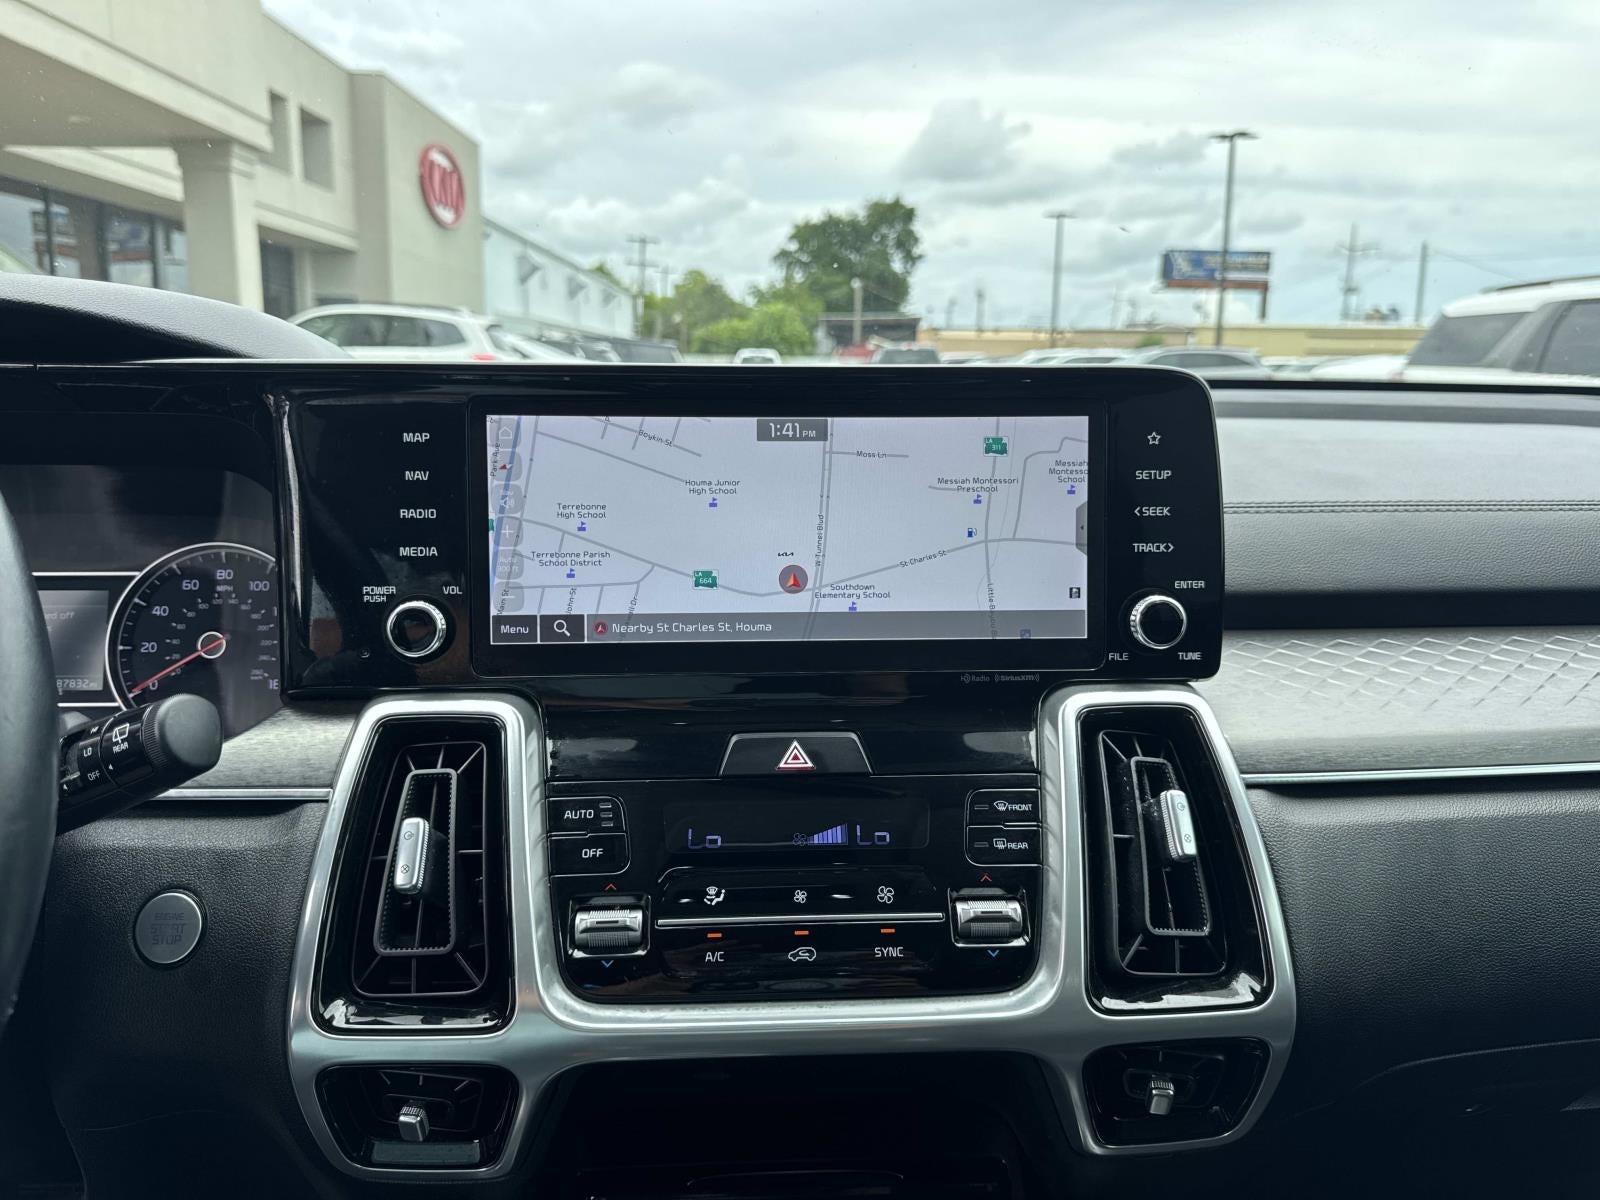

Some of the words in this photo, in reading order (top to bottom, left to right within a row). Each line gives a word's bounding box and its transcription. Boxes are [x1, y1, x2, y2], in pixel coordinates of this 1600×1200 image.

[769, 422, 800, 438] 1:41
[802, 430, 816, 438] PM
[402, 432, 430, 443] MAP
[856, 450, 876, 458] Moss
[877, 451, 887, 459] Ln
[404, 470, 430, 481] NAV
[937, 477, 970, 485] Messiah
[972, 476, 1019, 485] Montessori
[1057, 475, 1086, 484] School
[1135, 470, 1172, 480] SETUP
[685, 479, 711, 487] Houma
[713, 479, 741, 487] Junior
[956, 484, 999, 493] Preschool
[688, 487, 707, 496] High
[708, 486, 737, 495] School
[556, 502, 607, 511] Terrebonne
[399, 508, 437, 519] RADIO
[556, 510, 575, 519] High
[577, 510, 607, 519] School
[399, 546, 438, 557] MEDIA
[531, 551, 581, 559] Terrebonne
[583, 551, 611, 559] Parish
[538, 559, 568, 567] School
[570, 559, 603, 567] District
[899, 560, 909, 568] St
[909, 552, 938, 565] Charles
[938, 549, 947, 557] St
[216, 569, 234, 580] 80
[182, 579, 200, 591] 60
[249, 580, 270, 592] 100
[362, 585, 396, 595] POWER
[442, 585, 463, 595] VOL
[830, 583, 875, 591] Southdown
[1174, 580, 1205, 589] ENTER
[363, 595, 387, 603] PUSH
[814, 591, 861, 600] Elementary
[863, 591, 891, 599] School
[151, 605, 169, 617] 40
[500, 624, 529, 635] Menu
[612, 623, 654, 635] Nearby
[656, 622, 670, 633] St
[672, 621, 715, 633] Charles
[717, 621, 733, 634] St,
[735, 621, 772, 632] Houma
[140, 641, 158, 653] 20
[1108, 652, 1129, 661] FILE
[1177, 651, 1203, 661] TUNE
[149, 680, 159, 691] 0
[83, 747, 92, 758] LO
[112, 741, 129, 755] REAR
[87, 769, 101, 781] OFF
[1007, 803, 1033, 812] FRONT
[563, 808, 594, 820] AUTO
[1007, 841, 1029, 850] REAR
[581, 848, 604, 859] OFF
[151, 934, 183, 946] STOP
[705, 950, 725, 963] A/C
[874, 945, 904, 958] SYNC
